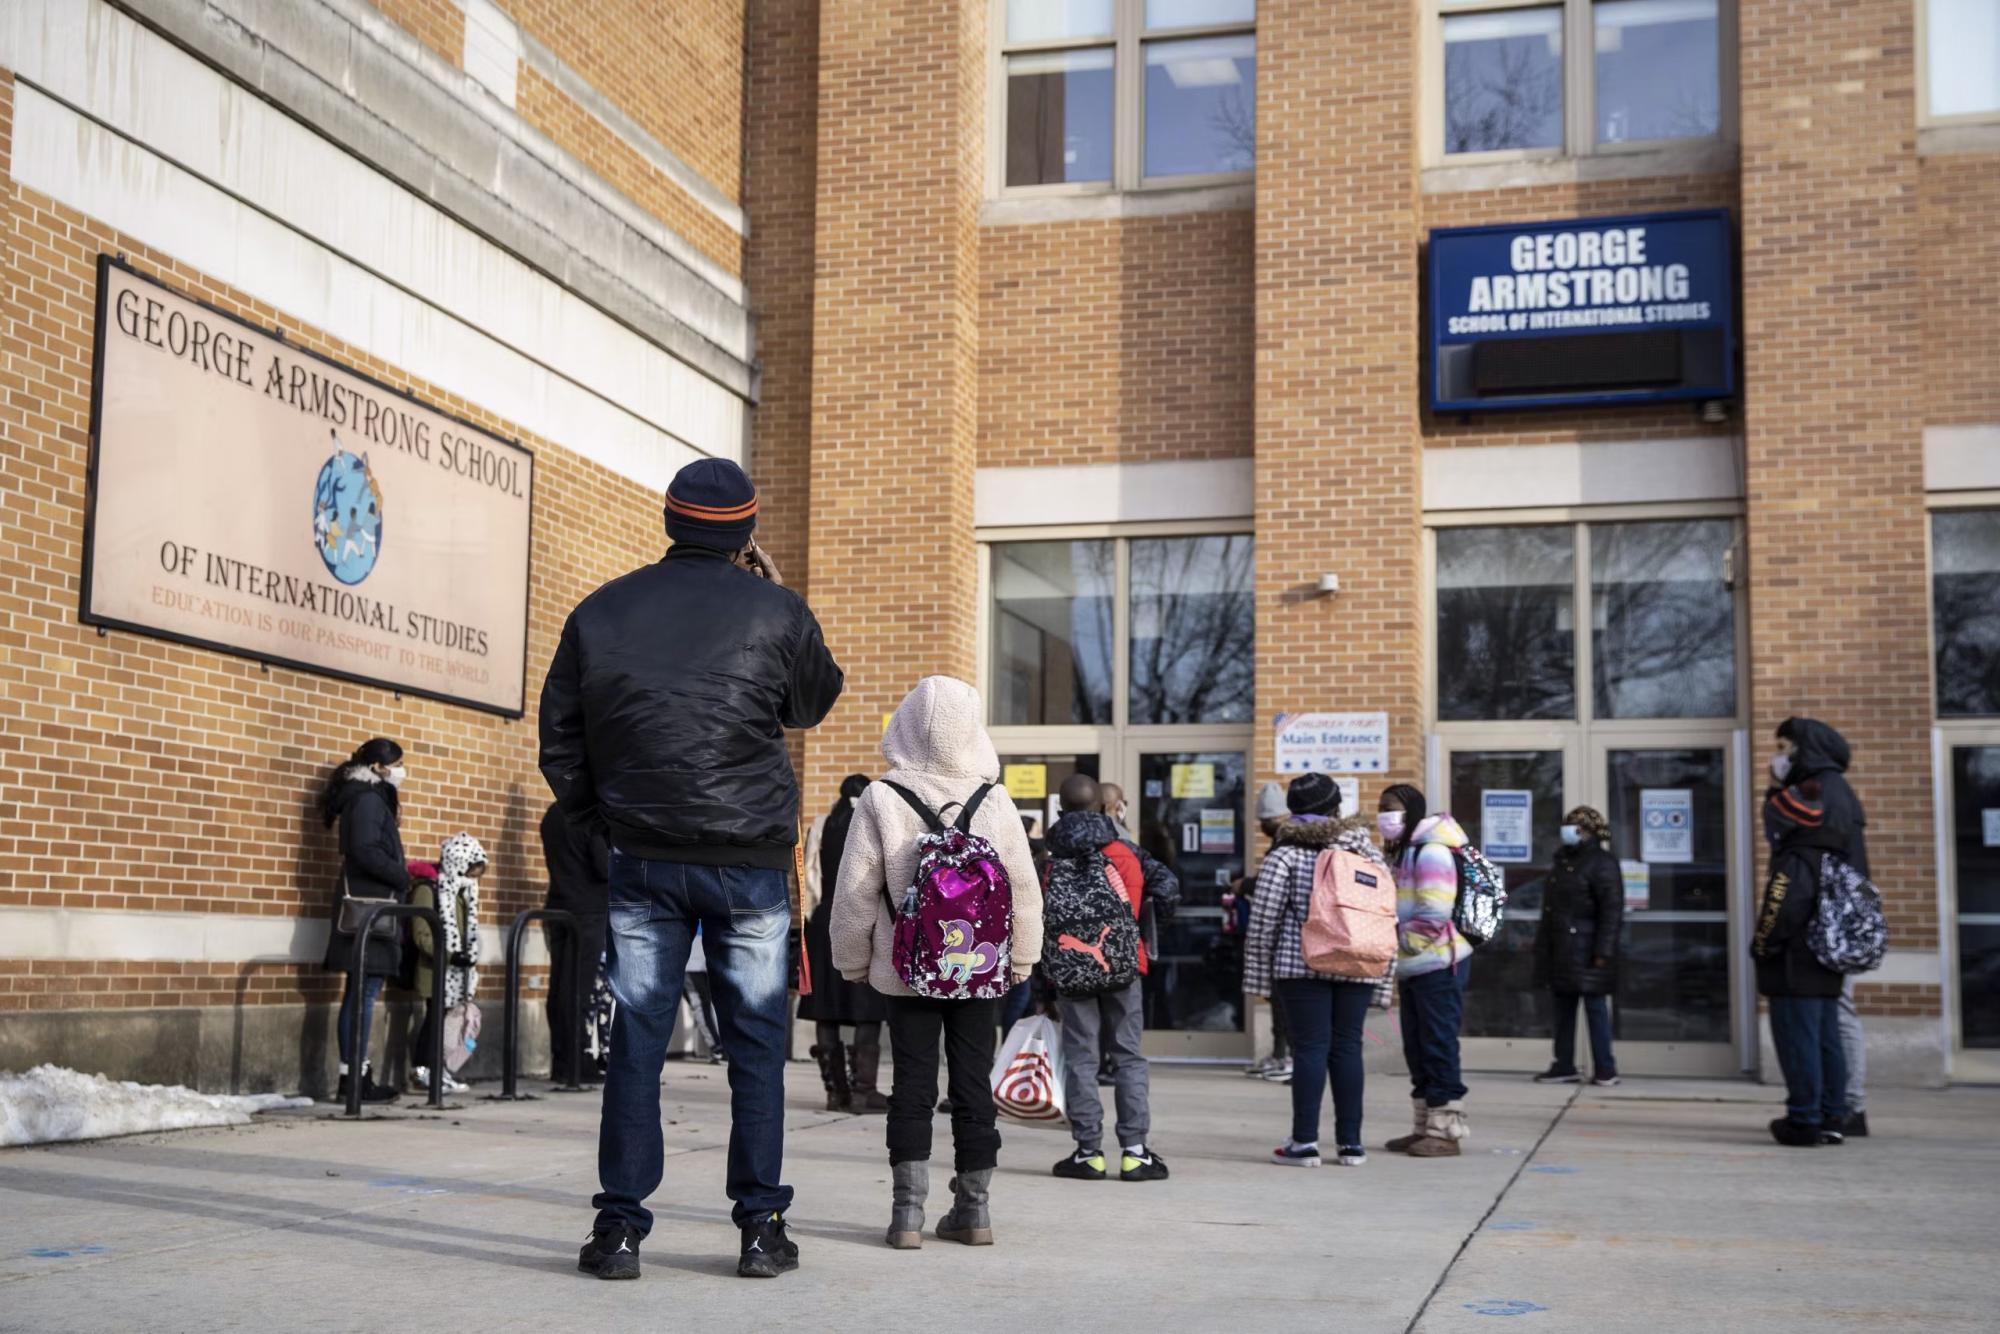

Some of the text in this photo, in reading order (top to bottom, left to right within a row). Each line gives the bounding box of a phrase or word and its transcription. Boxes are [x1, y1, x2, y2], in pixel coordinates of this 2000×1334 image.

[1510, 228, 1646, 272] GEORGE
[1468, 264, 1690, 312] ARMSTRONG
[1448, 302, 1711, 334] SCHOOL OF INTERNATIONAL STUDIES
[116, 289, 523, 498] GEORGE ARMSTRONG SCHOOL
[160, 540, 488, 657] OF INTERNATIONAL STUDIES
[258, 612, 273, 632] IS
[278, 618, 313, 642] OUR
[315, 626, 391, 660] PASSPORT
[400, 649, 415, 666] TO
[419, 653, 443, 675] THE
[445, 660, 489, 685] WORLD
[1282, 732, 1383, 745] Main Entrance
